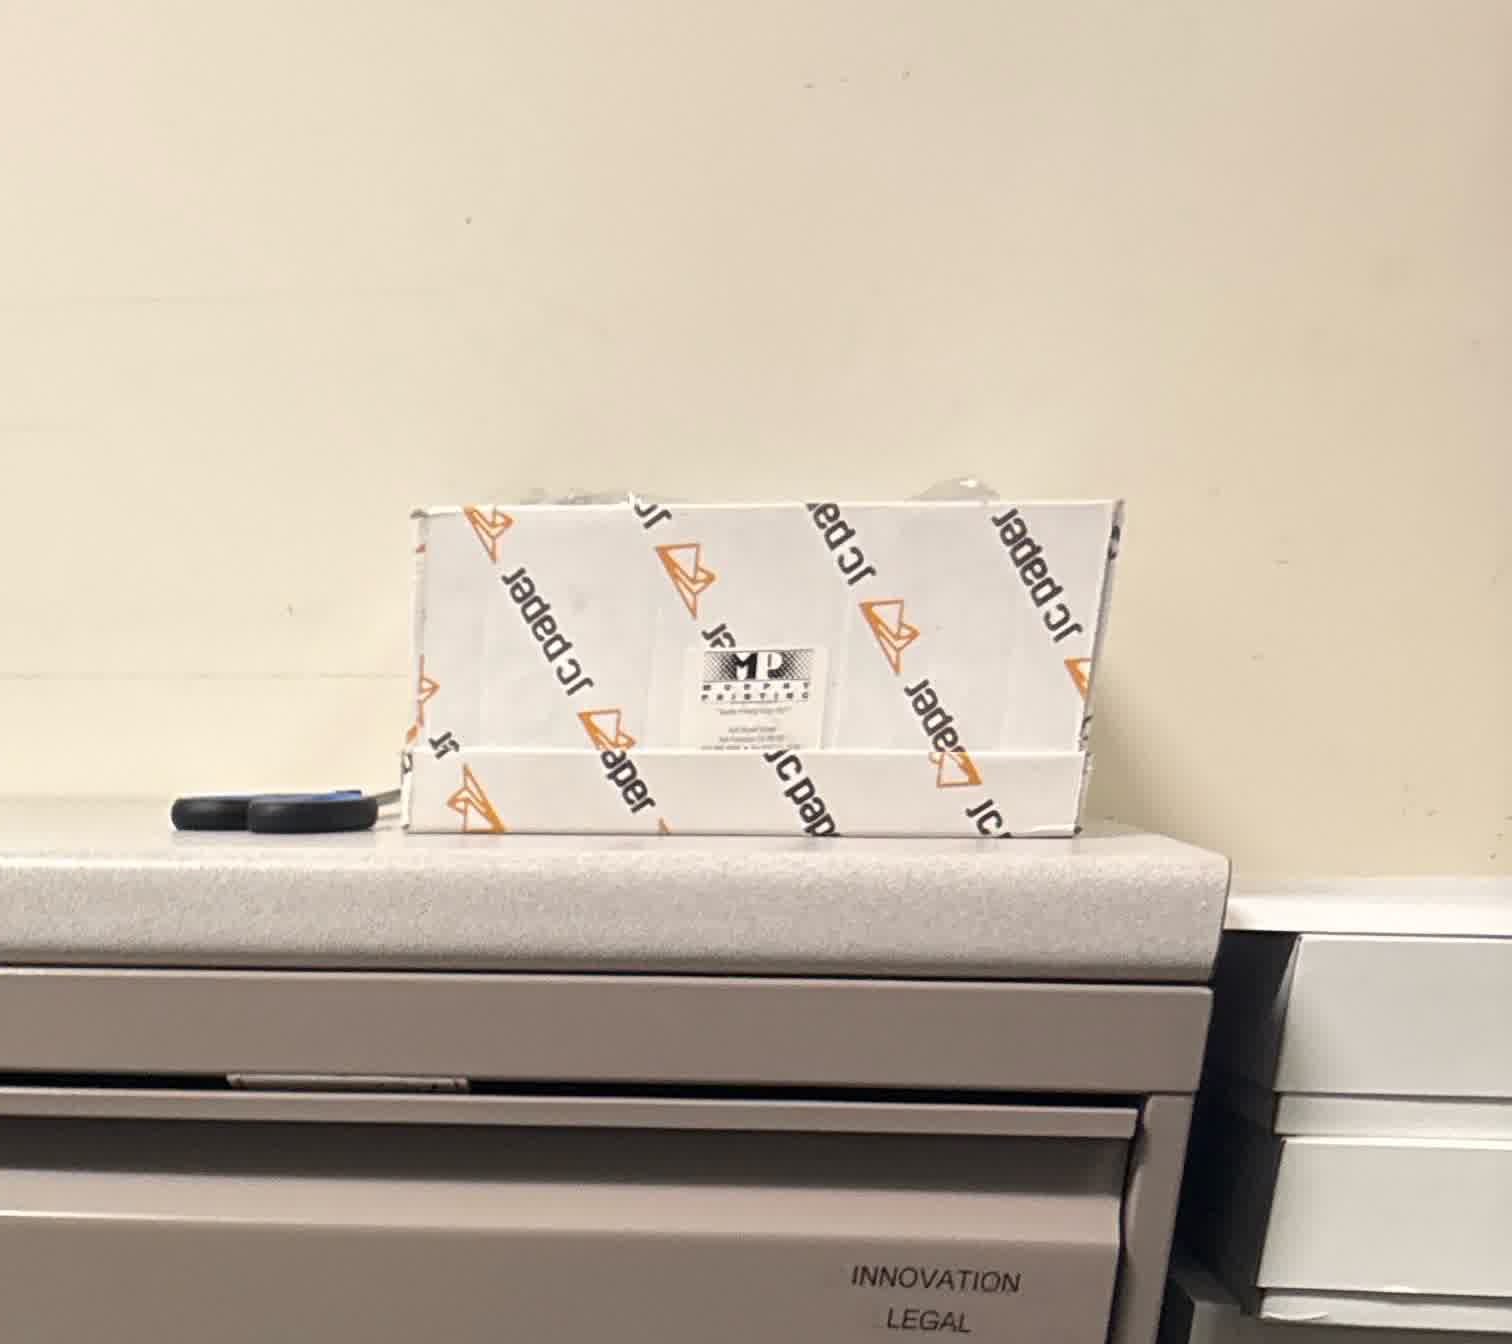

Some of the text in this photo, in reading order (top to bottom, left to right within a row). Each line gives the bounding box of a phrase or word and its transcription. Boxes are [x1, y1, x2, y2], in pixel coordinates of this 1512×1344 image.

[991, 508, 1063, 608] paper
[501, 567, 573, 662] paper
[903, 679, 965, 752] aper
[600, 749, 656, 813] aper
[784, 777, 841, 837] pap
[851, 1265, 1021, 1293] INNOVATION
[886, 1307, 972, 1333] LEGAL
